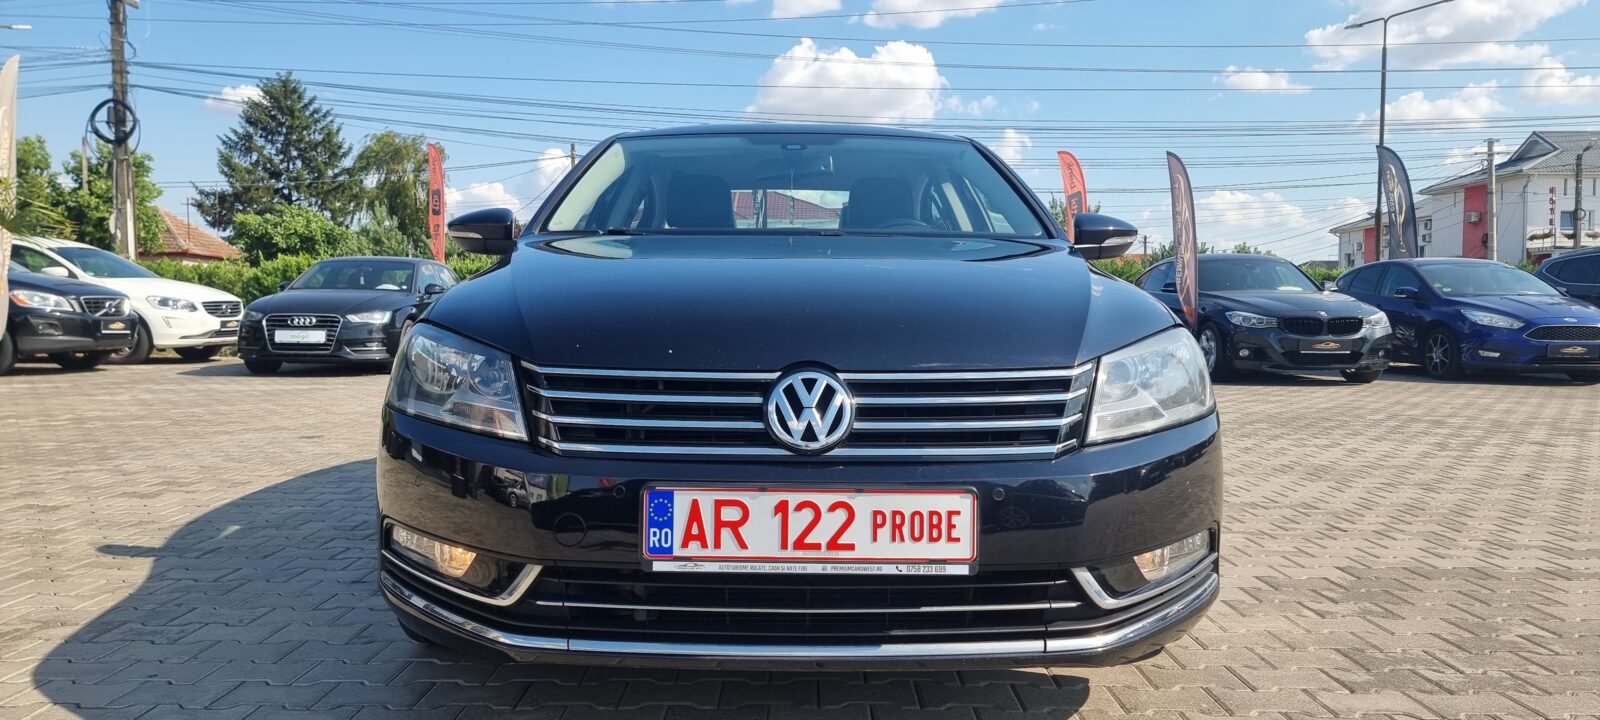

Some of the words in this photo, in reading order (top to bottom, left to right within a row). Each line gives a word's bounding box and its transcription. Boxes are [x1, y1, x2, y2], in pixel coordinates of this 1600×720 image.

[680, 498, 750, 550] AR
[773, 499, 856, 551] 122
[871, 509, 961, 543] PROBE
[649, 528, 672, 548] RO
[768, 564, 780, 572] CASH
[786, 564, 797, 572] RATE
[906, 565, 921, 573] 0758
[922, 565, 933, 573] 233
[934, 565, 946, 574] 699
